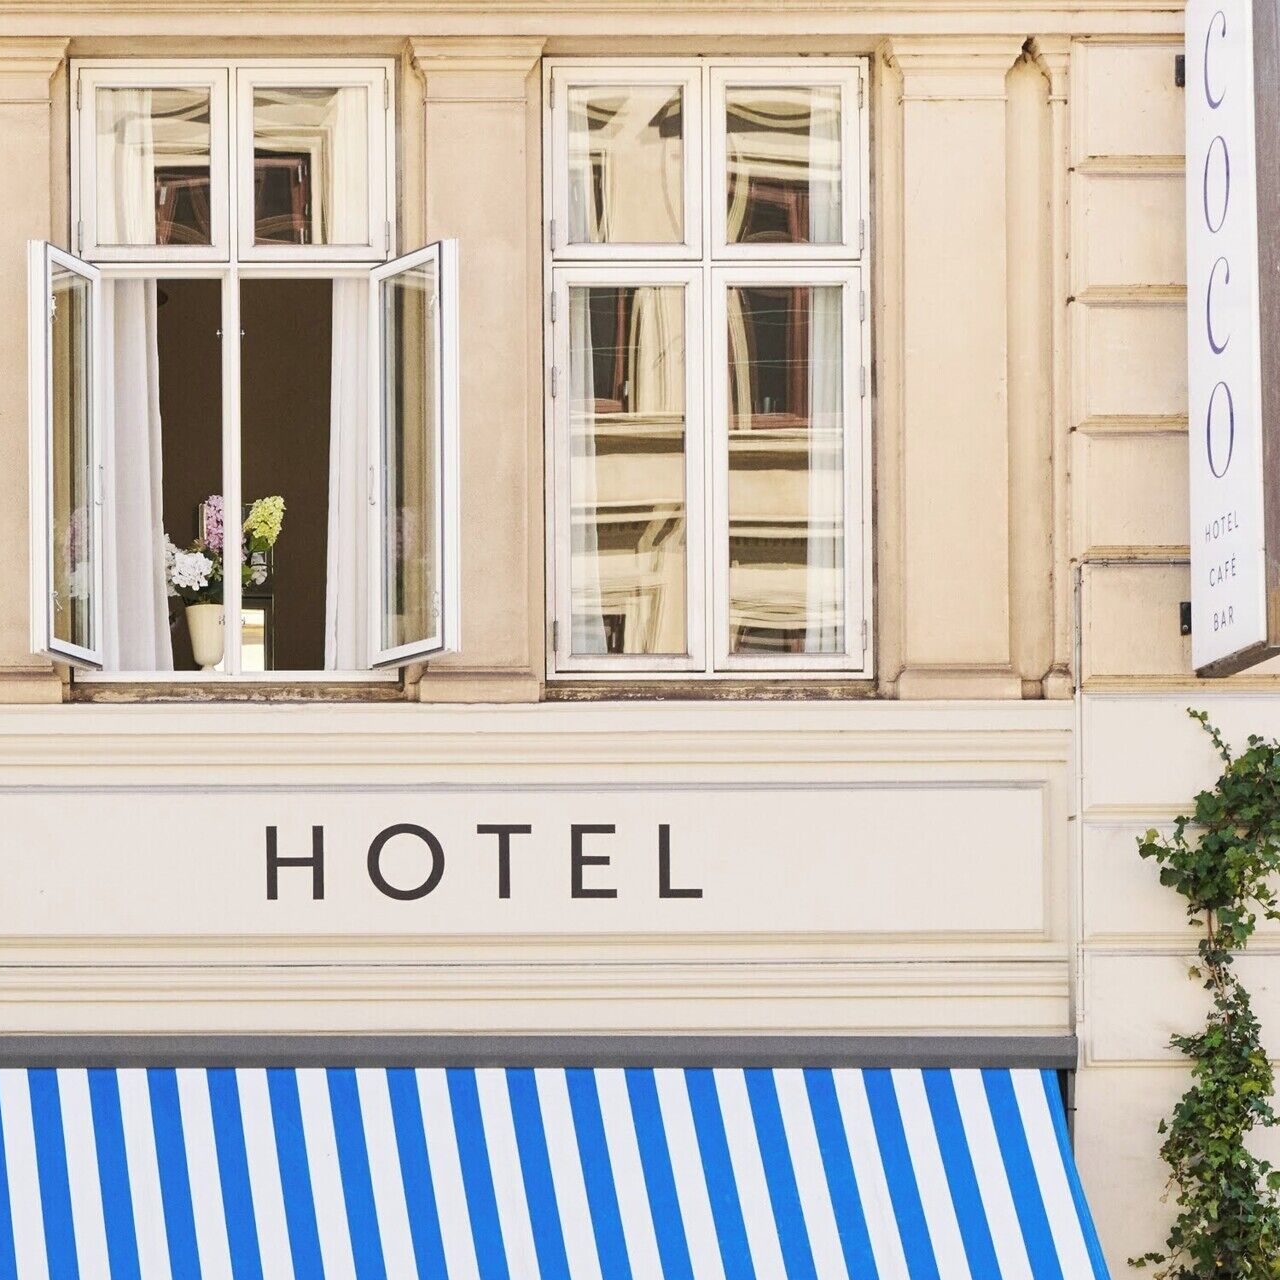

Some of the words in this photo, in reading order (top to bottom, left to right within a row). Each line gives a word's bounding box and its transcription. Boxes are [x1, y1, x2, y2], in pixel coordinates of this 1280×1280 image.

[1203, 9, 1235, 479] COCO
[1205, 510, 1239, 541] HOTEL
[1209, 552, 1236, 587] CAFÉ
[1213, 605, 1234, 632] BAR
[265, 823, 703, 901] HOTEL
